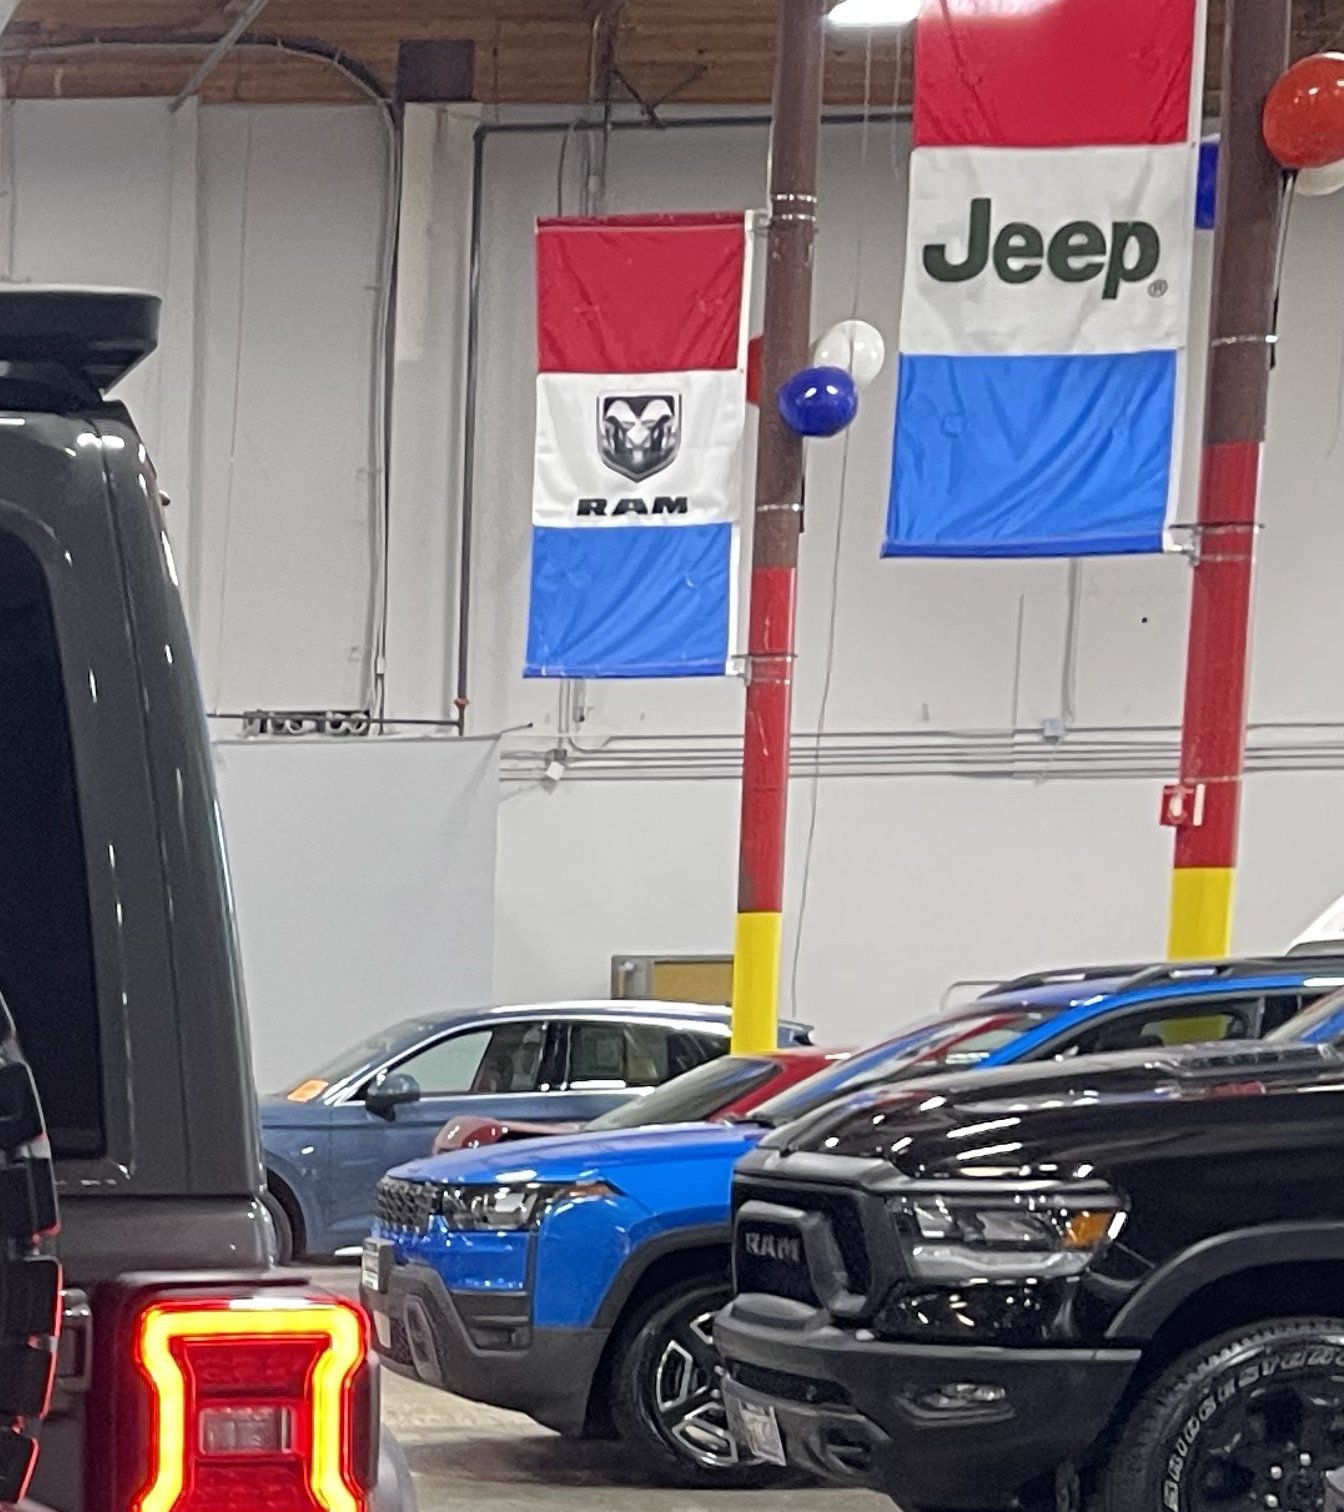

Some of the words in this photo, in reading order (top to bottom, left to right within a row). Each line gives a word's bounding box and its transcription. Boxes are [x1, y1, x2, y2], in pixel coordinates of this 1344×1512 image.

[922, 197, 1160, 300] Jeep
[576, 496, 688, 516] RAM
[745, 1231, 800, 1262] RAM
